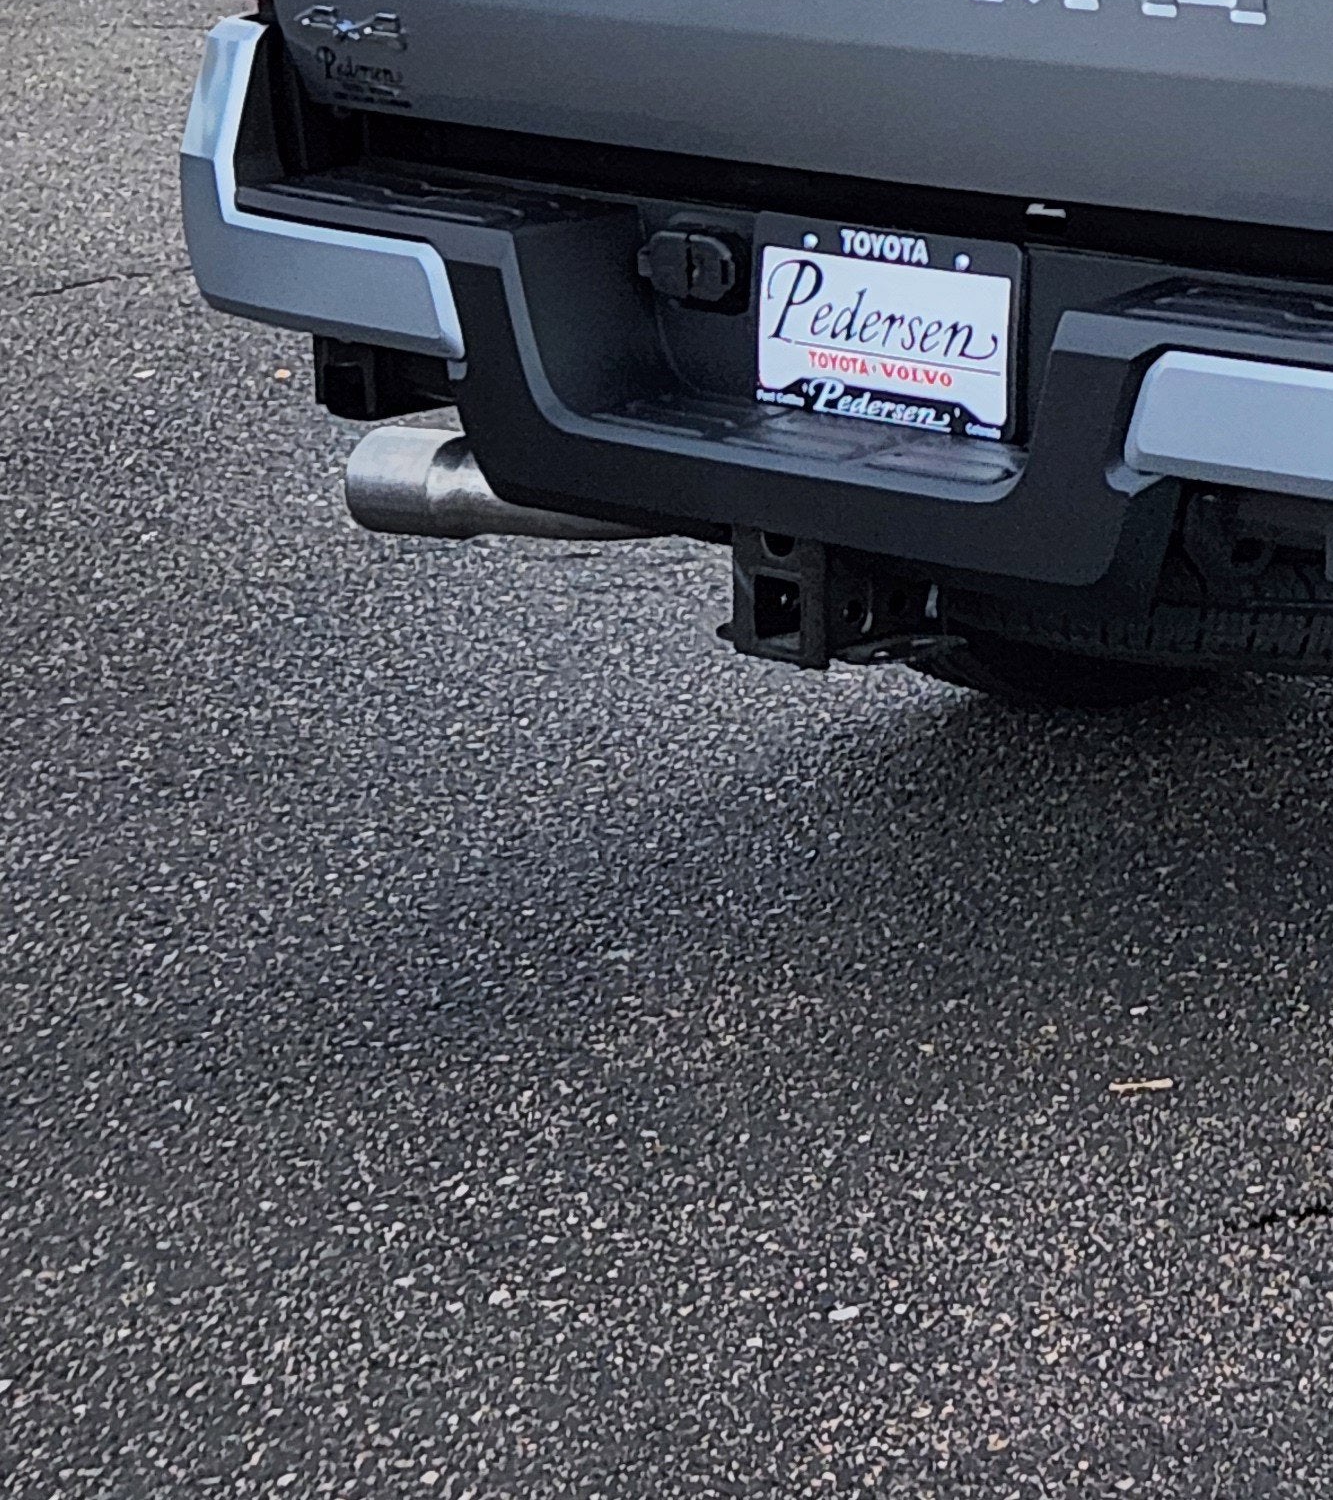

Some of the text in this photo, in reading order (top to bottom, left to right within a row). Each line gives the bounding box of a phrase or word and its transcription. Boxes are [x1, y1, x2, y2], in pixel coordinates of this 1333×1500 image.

[840, 229, 929, 265] TOYOTA
[767, 259, 998, 360] Pedersen
[808, 350, 953, 387] TOYOTA VOLVO
